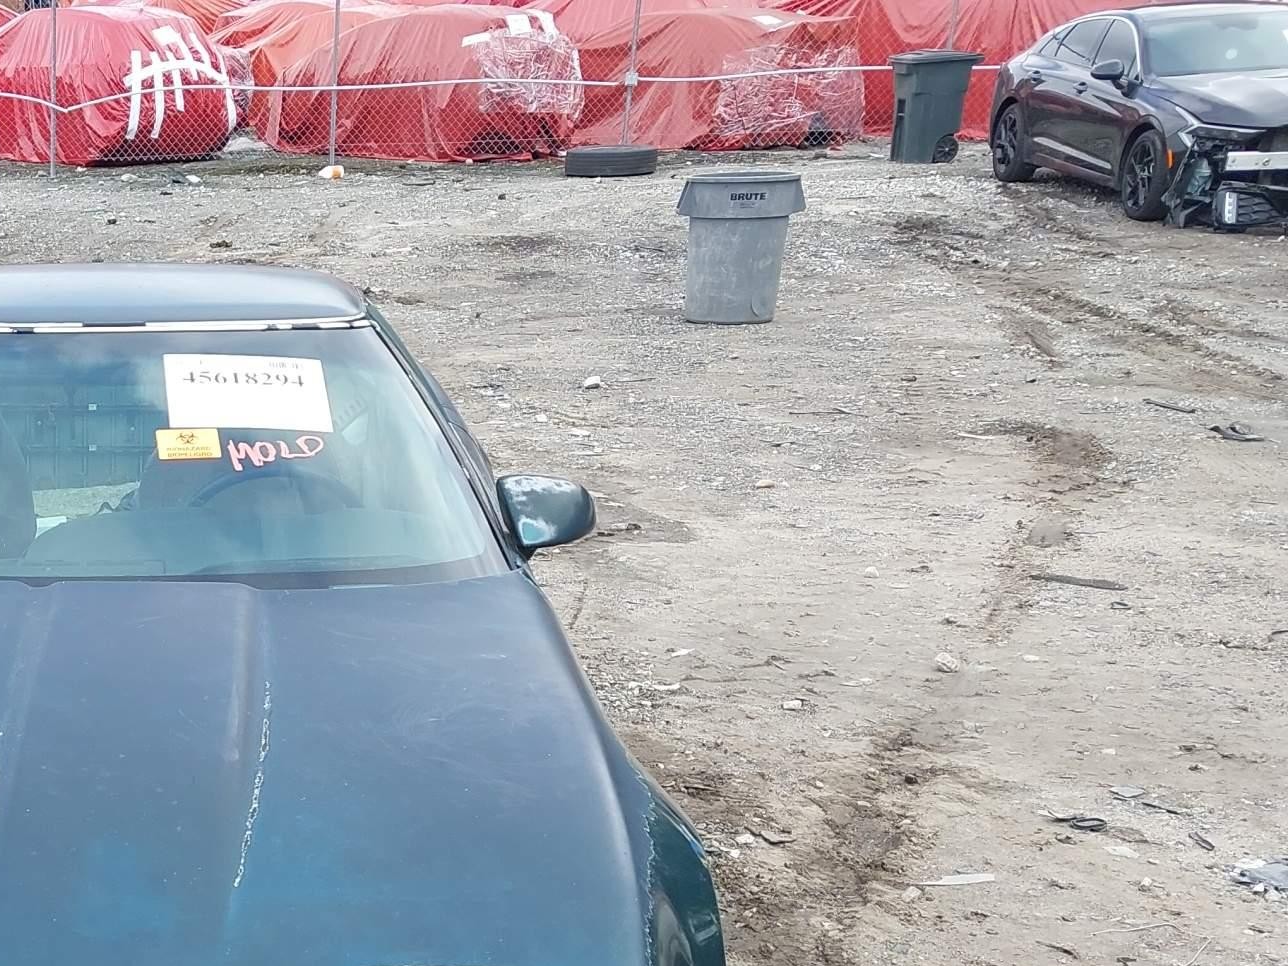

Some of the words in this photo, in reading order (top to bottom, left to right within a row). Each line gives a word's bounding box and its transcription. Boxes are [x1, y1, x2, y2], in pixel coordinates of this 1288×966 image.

[730, 192, 768, 201] BRUTE
[182, 370, 305, 387] 45618294
[227, 435, 325, 472] MOLD
